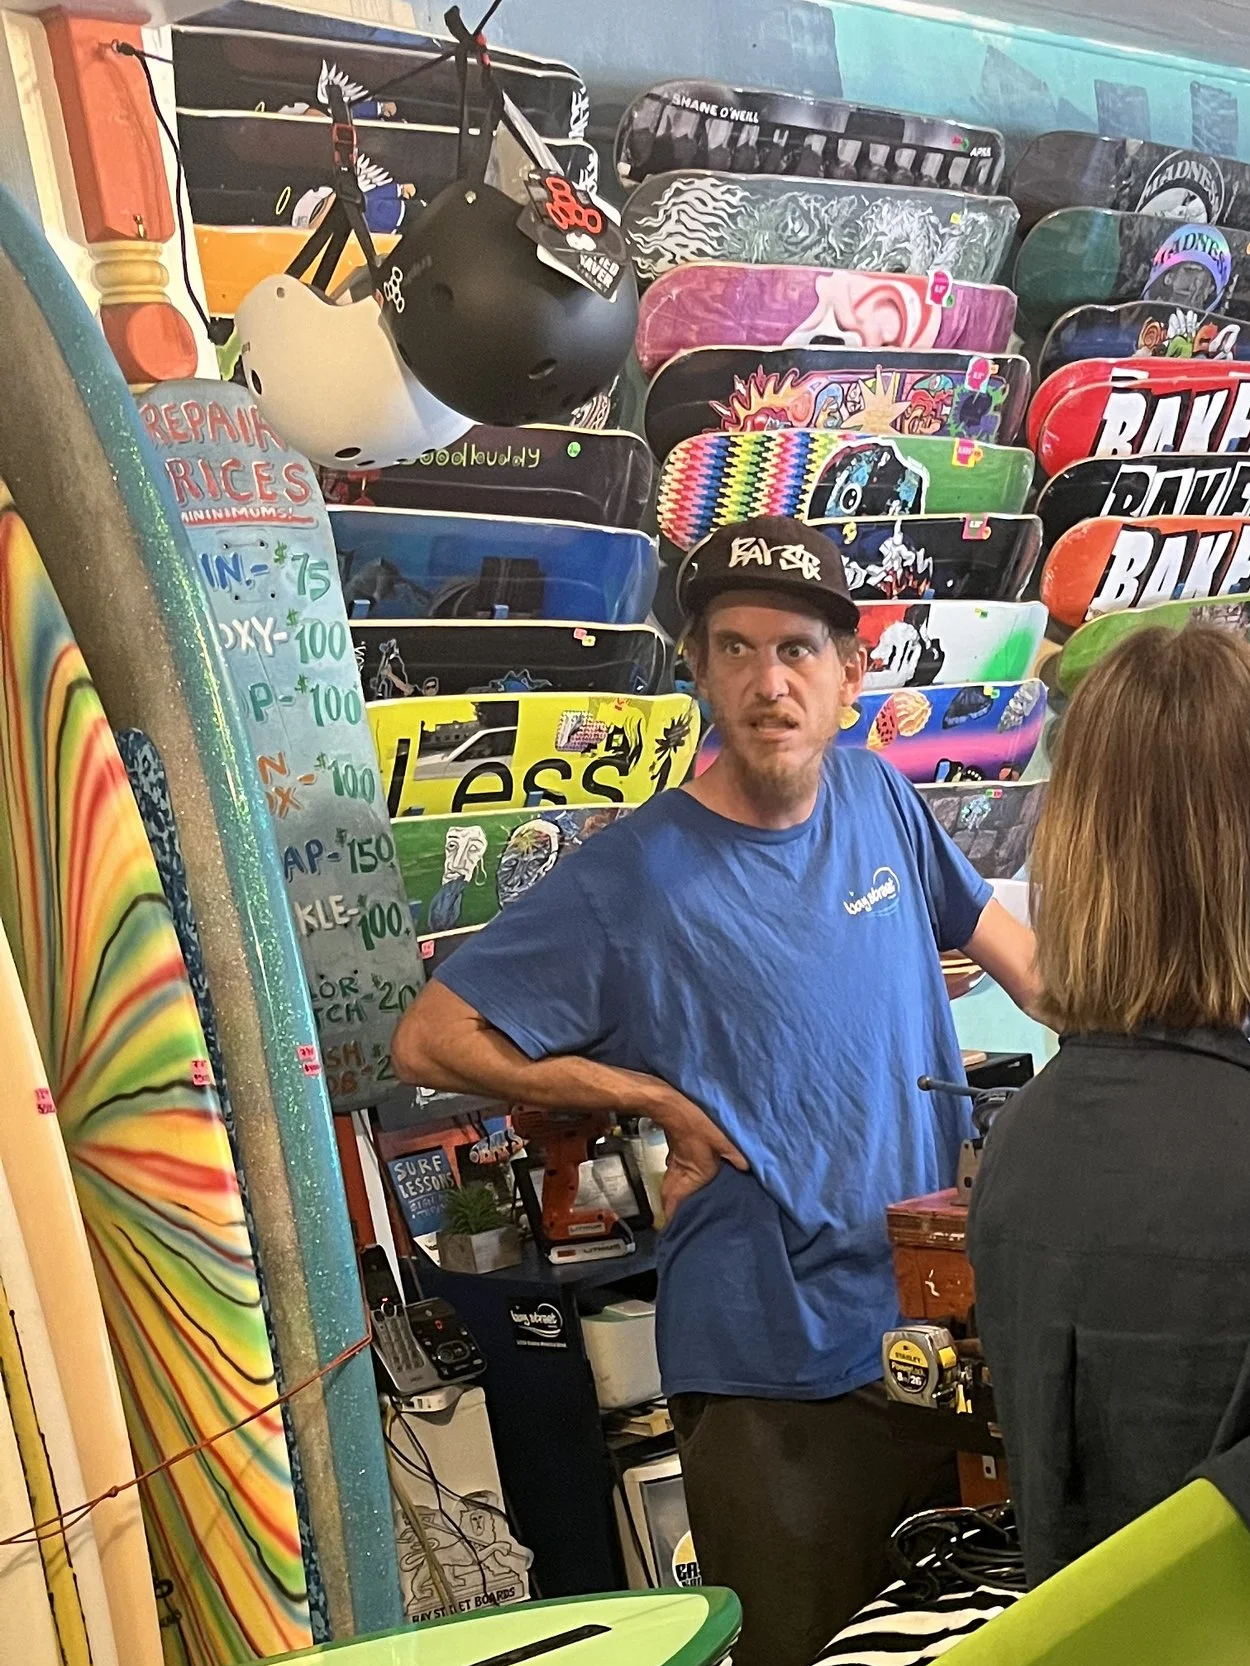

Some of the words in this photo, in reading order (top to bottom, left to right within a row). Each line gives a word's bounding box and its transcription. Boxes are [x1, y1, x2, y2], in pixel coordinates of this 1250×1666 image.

[672, 93, 718, 117] SHANE
[720, 107, 759, 123] O'NEILL
[412, 442, 541, 468] oodbuddy
[165, 456, 312, 506] RICES
[286, 609, 347, 664] $100
[394, 1155, 442, 1182] SURF
[398, 1172, 454, 1199] LESSONS
[475, 1586, 516, 1608] BOARDS
